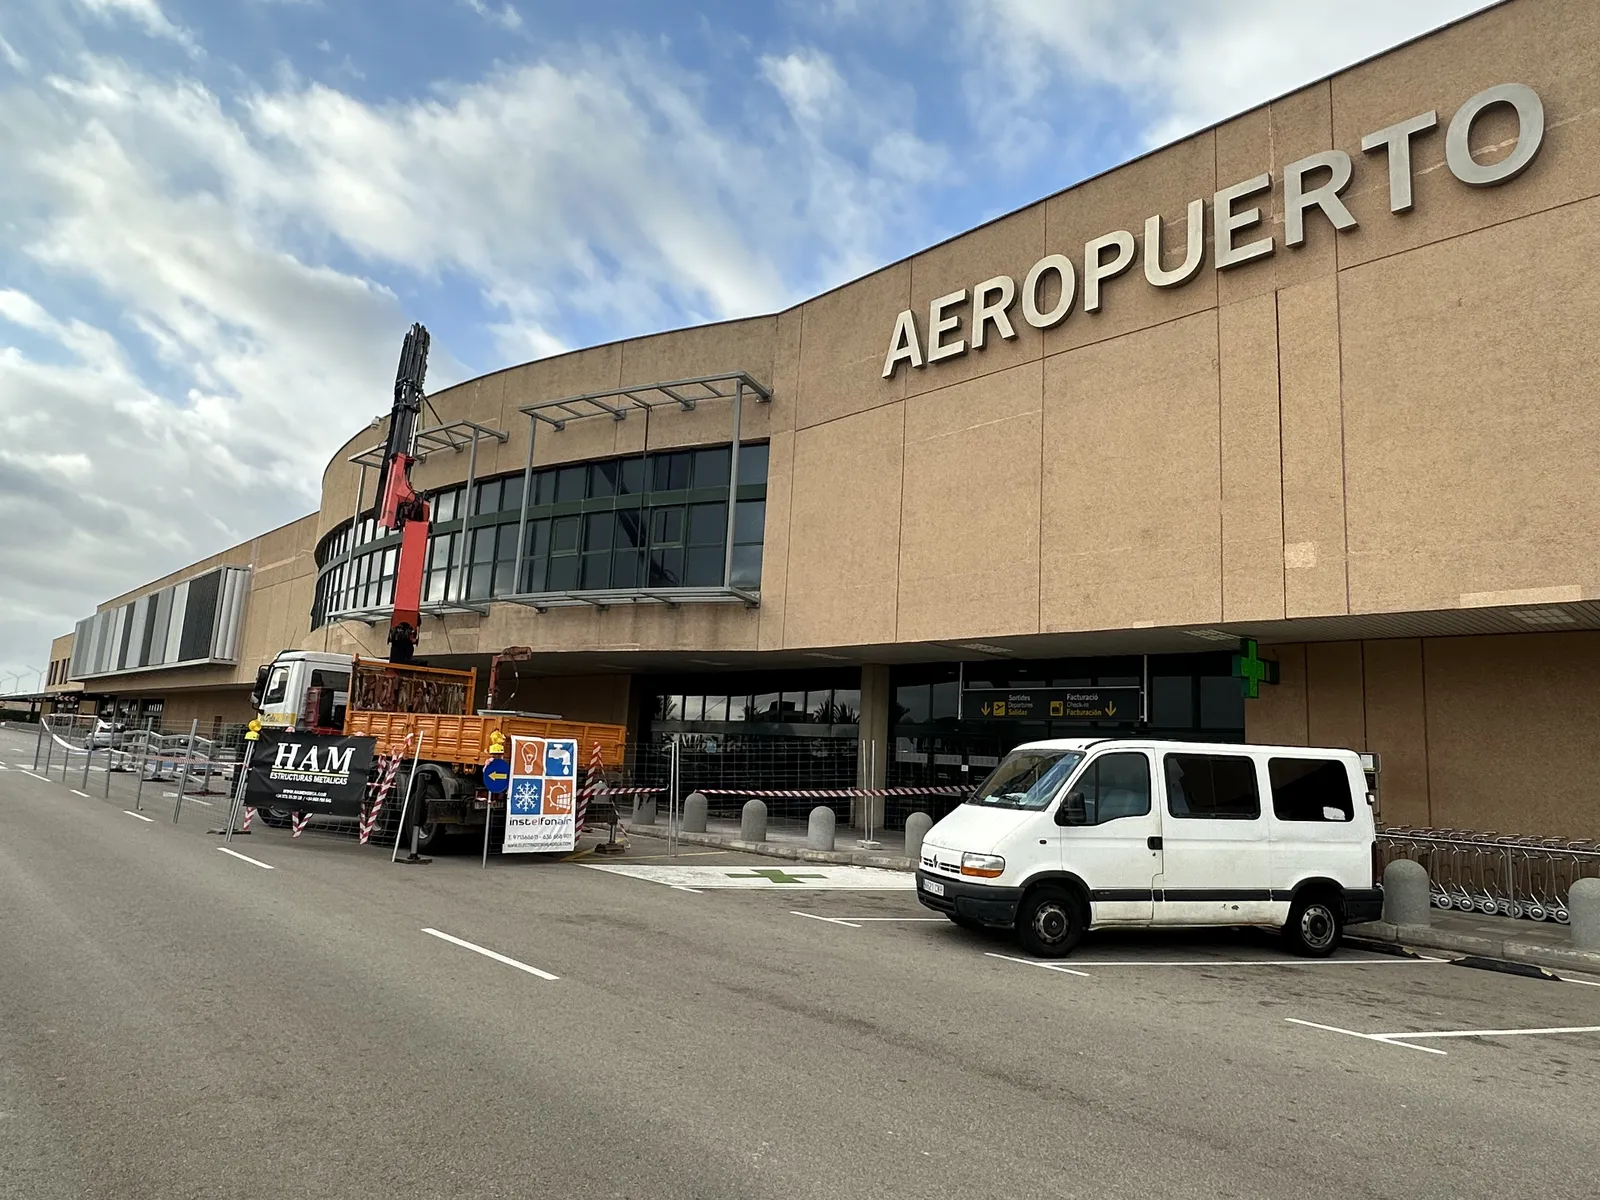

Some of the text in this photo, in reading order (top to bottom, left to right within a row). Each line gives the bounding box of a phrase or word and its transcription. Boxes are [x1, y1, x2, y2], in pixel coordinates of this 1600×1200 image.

[882, 82, 1545, 378] AEROPUERTO
[1066, 693, 1099, 701] Facturació
[1066, 708, 1102, 716] Facturación
[271, 742, 356, 774] HAM
[270, 772, 313, 782] ESTRUCTURAS
[509, 816, 572, 826] instelfonair
